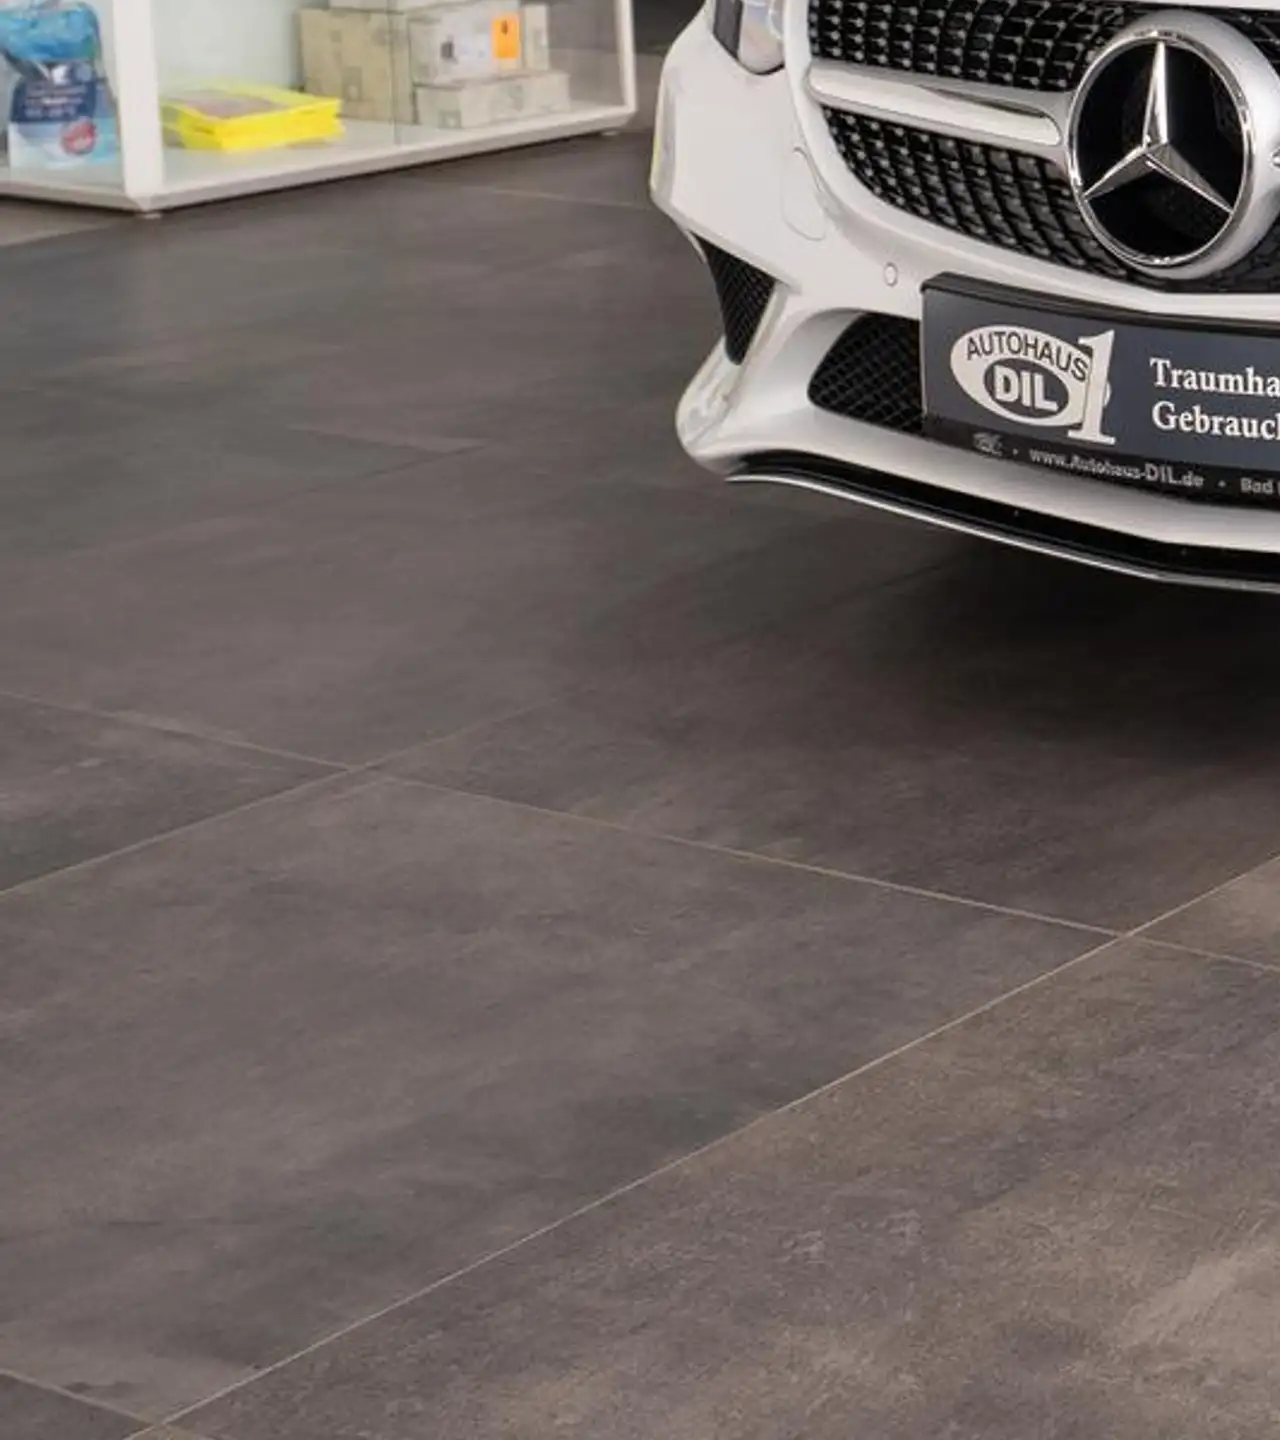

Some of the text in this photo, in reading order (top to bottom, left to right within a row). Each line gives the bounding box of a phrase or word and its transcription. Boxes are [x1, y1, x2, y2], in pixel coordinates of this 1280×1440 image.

[967, 331, 1089, 382] AUTOHAUS
[993, 363, 1060, 413] DIL
[1028, 447, 1205, 488] www.Autohaus-DIL.de
[1240, 476, 1275, 496] Bad
